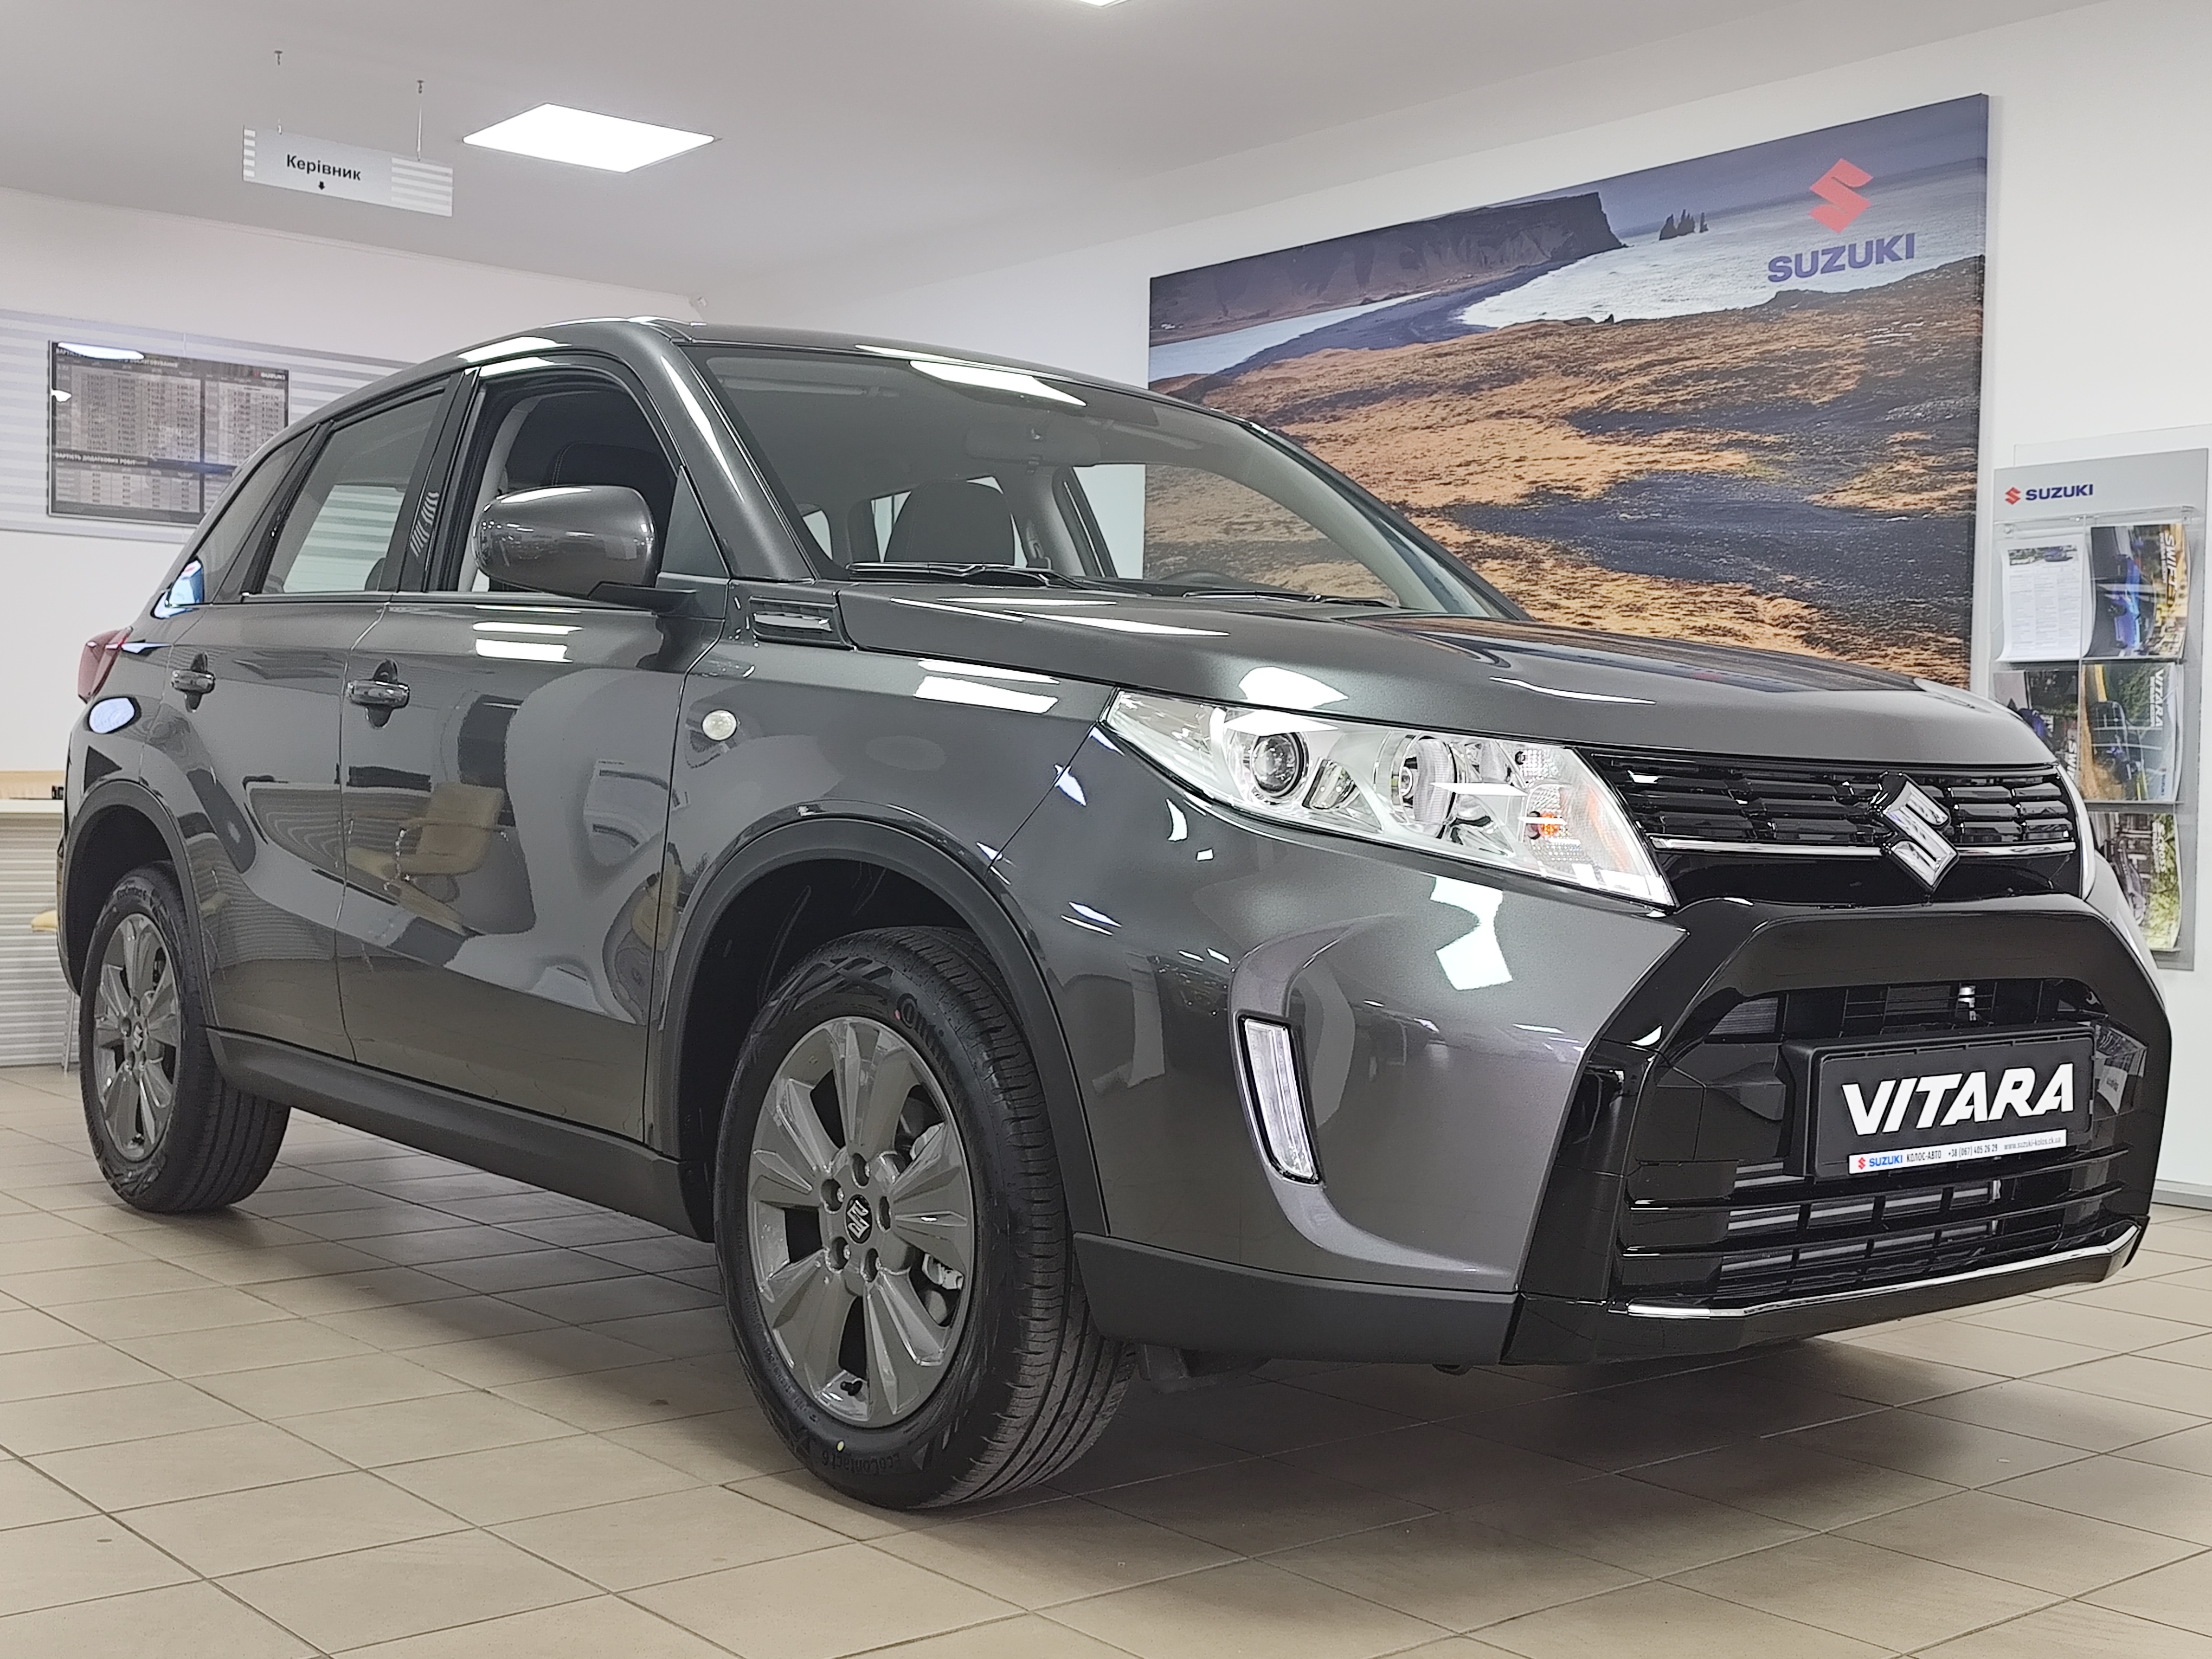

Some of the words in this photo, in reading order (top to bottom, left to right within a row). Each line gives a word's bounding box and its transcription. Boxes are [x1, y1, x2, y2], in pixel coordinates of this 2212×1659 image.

[286, 153, 362, 181] Керівник
[1767, 233, 1915, 282] SUZUKI
[2025, 484, 2094, 501] SUZUKI
[2164, 532, 2178, 590] SWIFT
[2155, 668, 2164, 728] VITARA
[2066, 740, 2078, 781] SWIF
[1841, 1062, 2075, 1136] VITARA
[1869, 1154, 1903, 1167] SUZUKI
[1906, 1150, 1942, 1162] КОЛОС-АВТО
[1958, 1145, 1973, 1158] (067)
